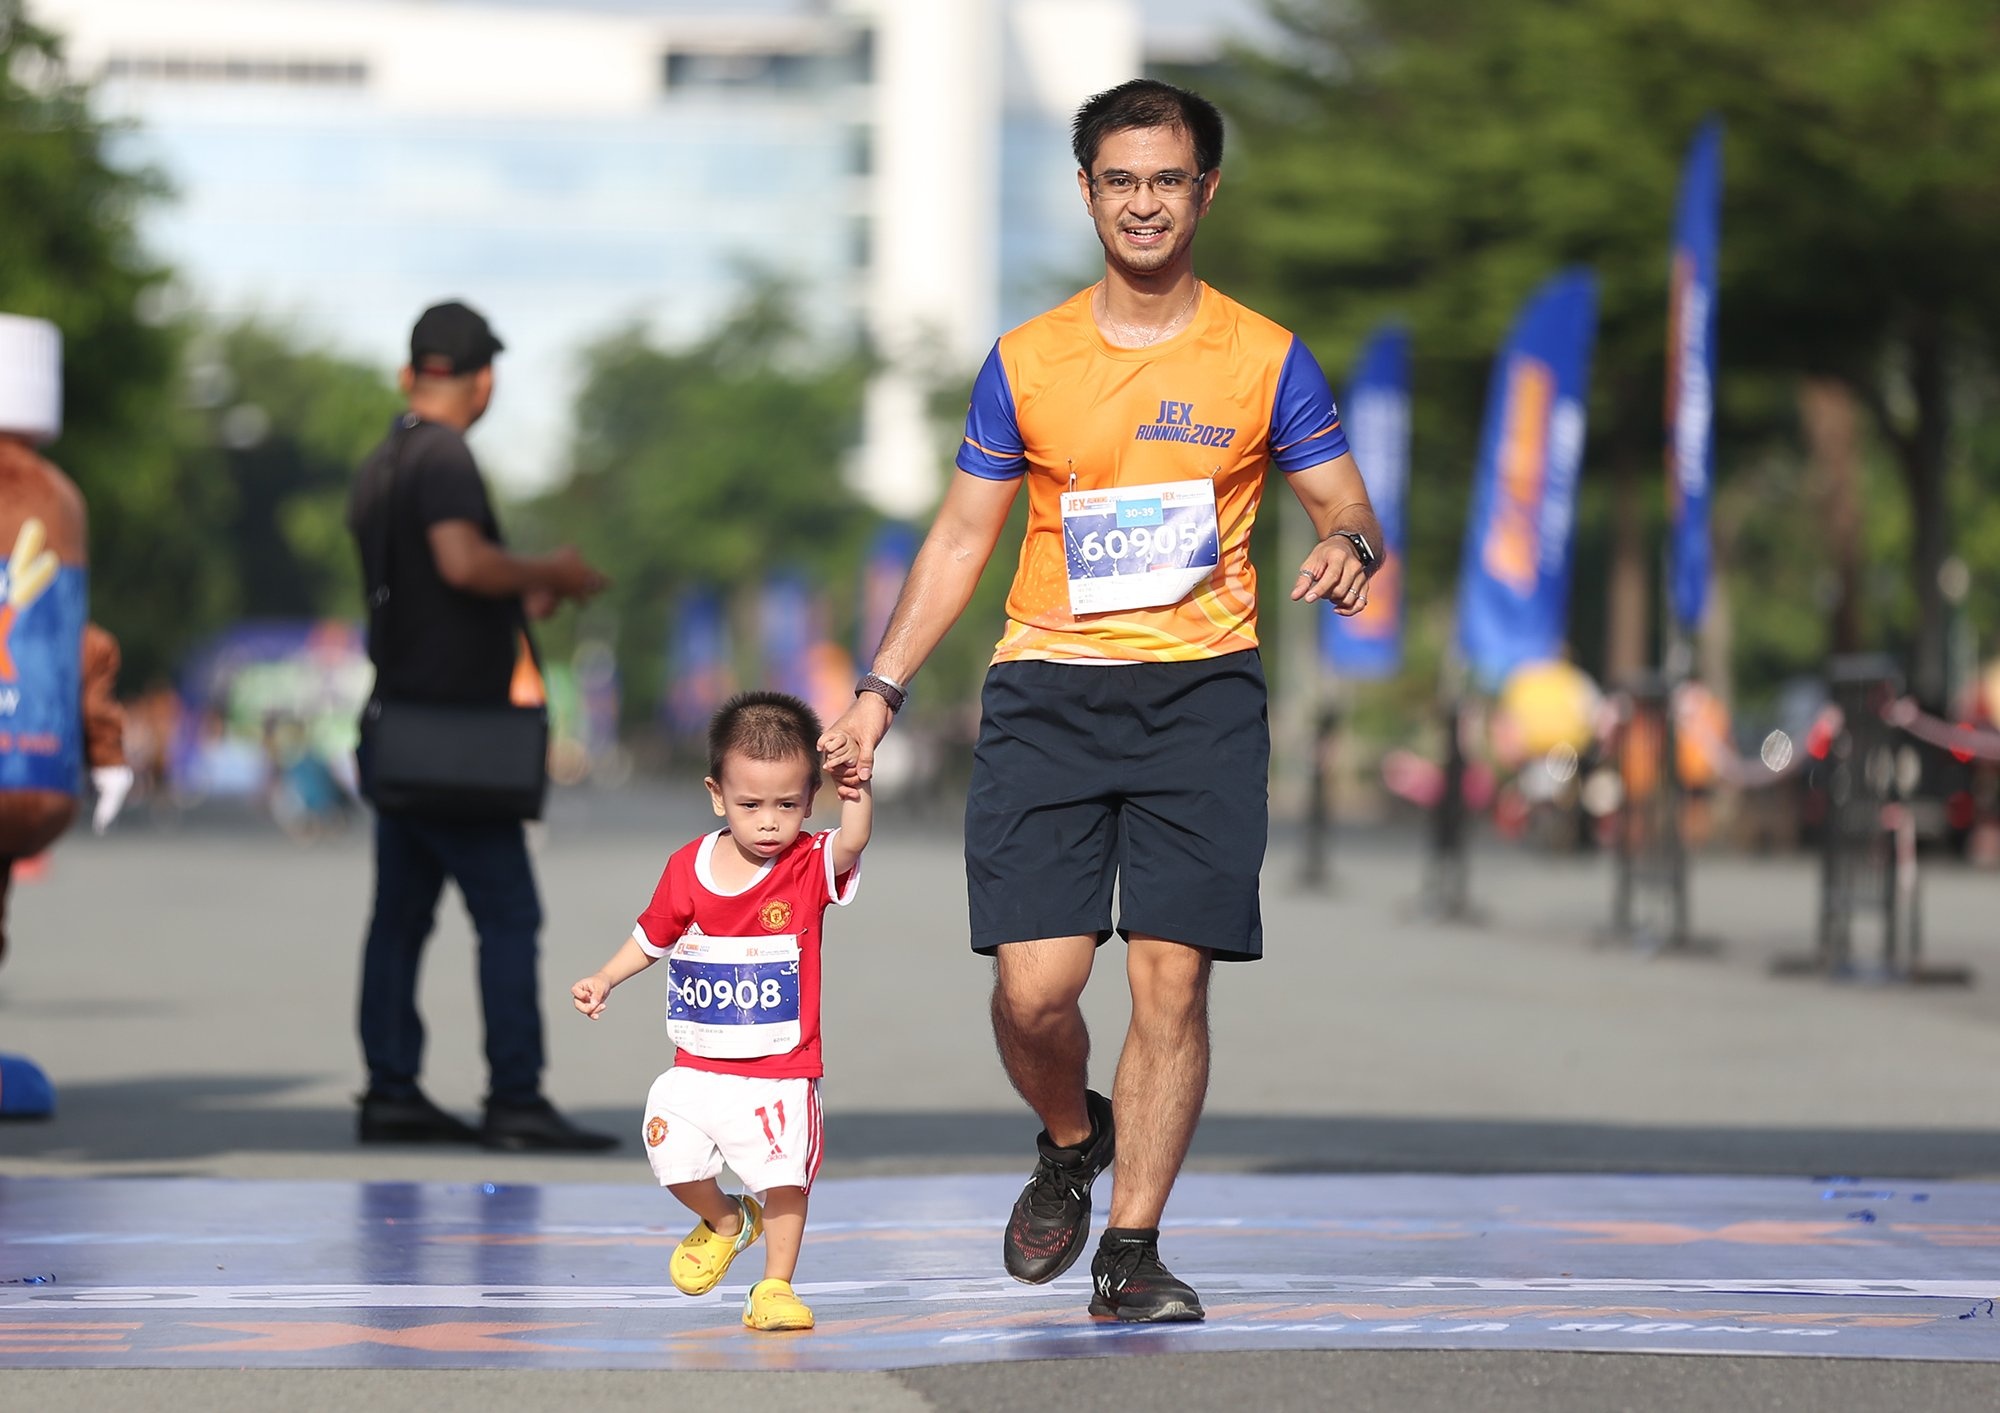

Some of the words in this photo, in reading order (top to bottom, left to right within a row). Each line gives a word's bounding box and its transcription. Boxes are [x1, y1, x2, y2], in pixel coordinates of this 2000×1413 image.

[1155, 400, 1194, 426] JEX
[1135, 425, 1191, 443] RUNNING
[1189, 424, 1236, 449] 2022
[1067, 498, 1087, 512] JEX
[1162, 491, 1175, 502] JEX
[1125, 507, 1155, 519] 30-39
[1081, 522, 1200, 562] 60905
[683, 976, 782, 1011] 60908
[755, 1099, 786, 1146] 11
